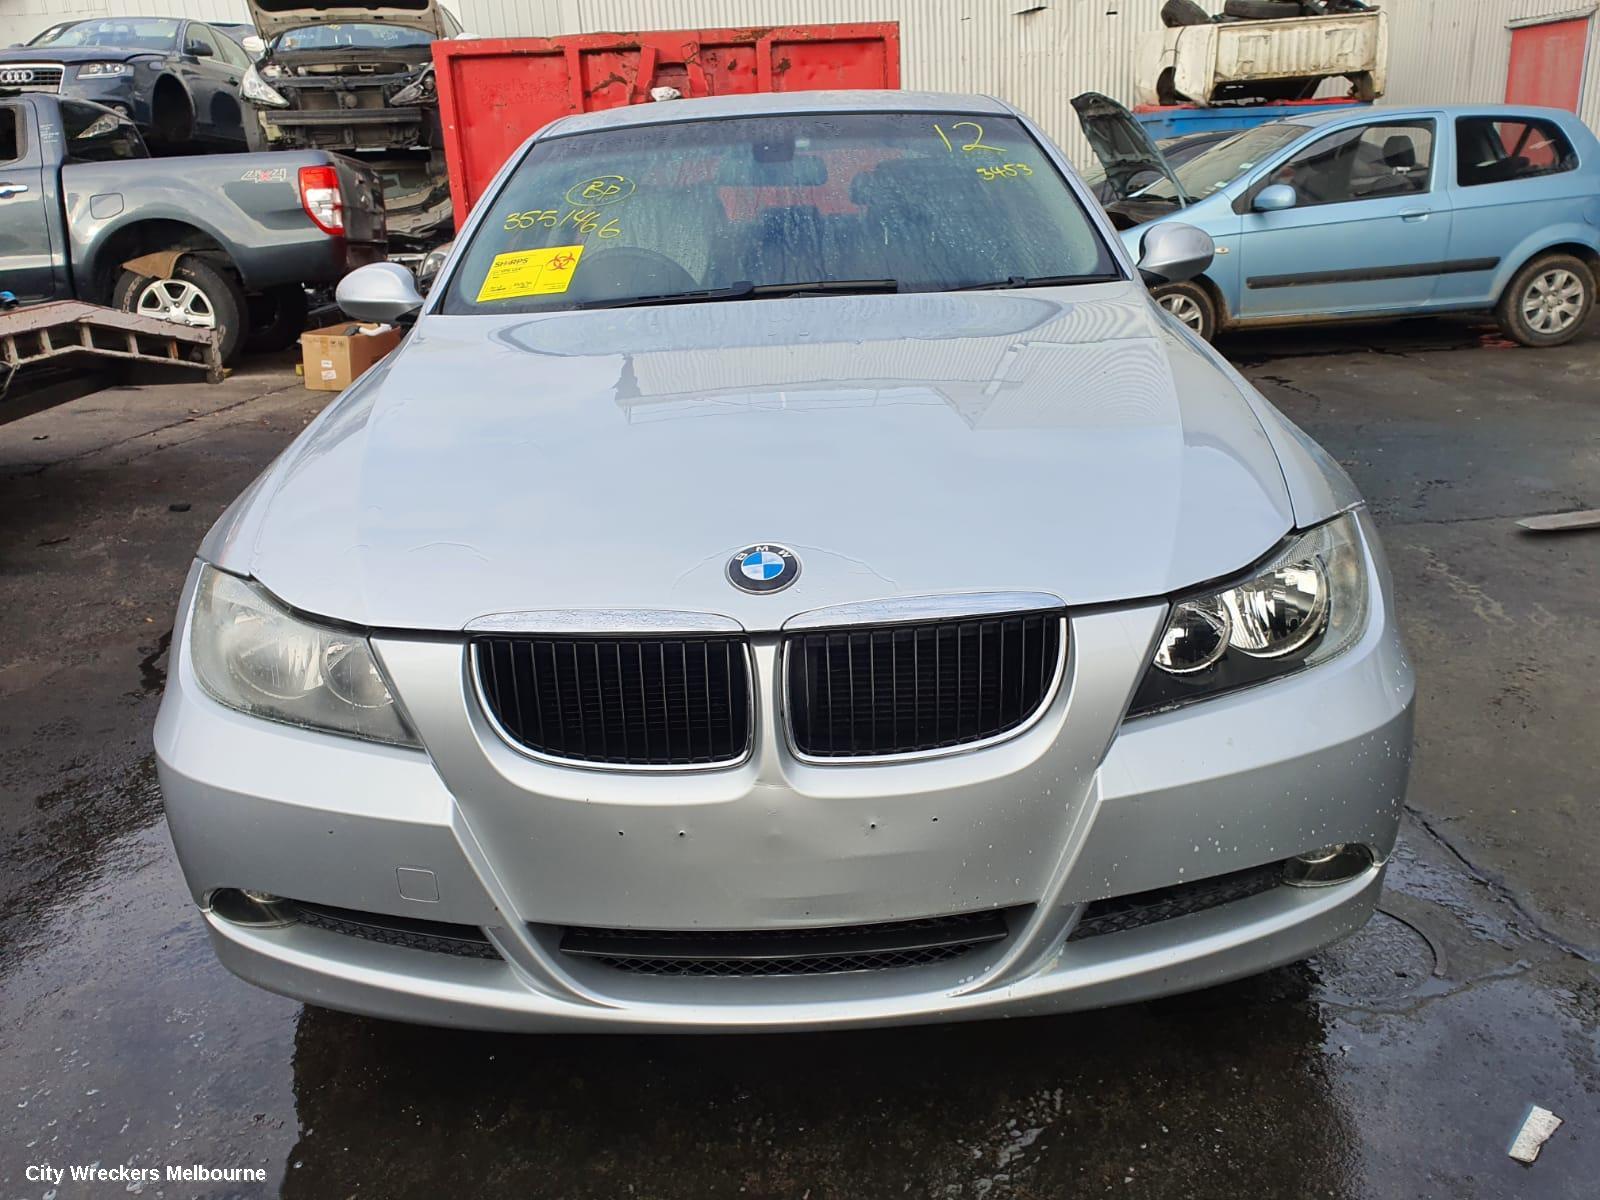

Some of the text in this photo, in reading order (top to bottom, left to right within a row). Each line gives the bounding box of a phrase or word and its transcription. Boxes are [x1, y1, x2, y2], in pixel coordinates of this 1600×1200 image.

[934, 122, 1008, 152] 12
[976, 163, 1033, 181] 3453
[735, 545, 792, 561] BMW
